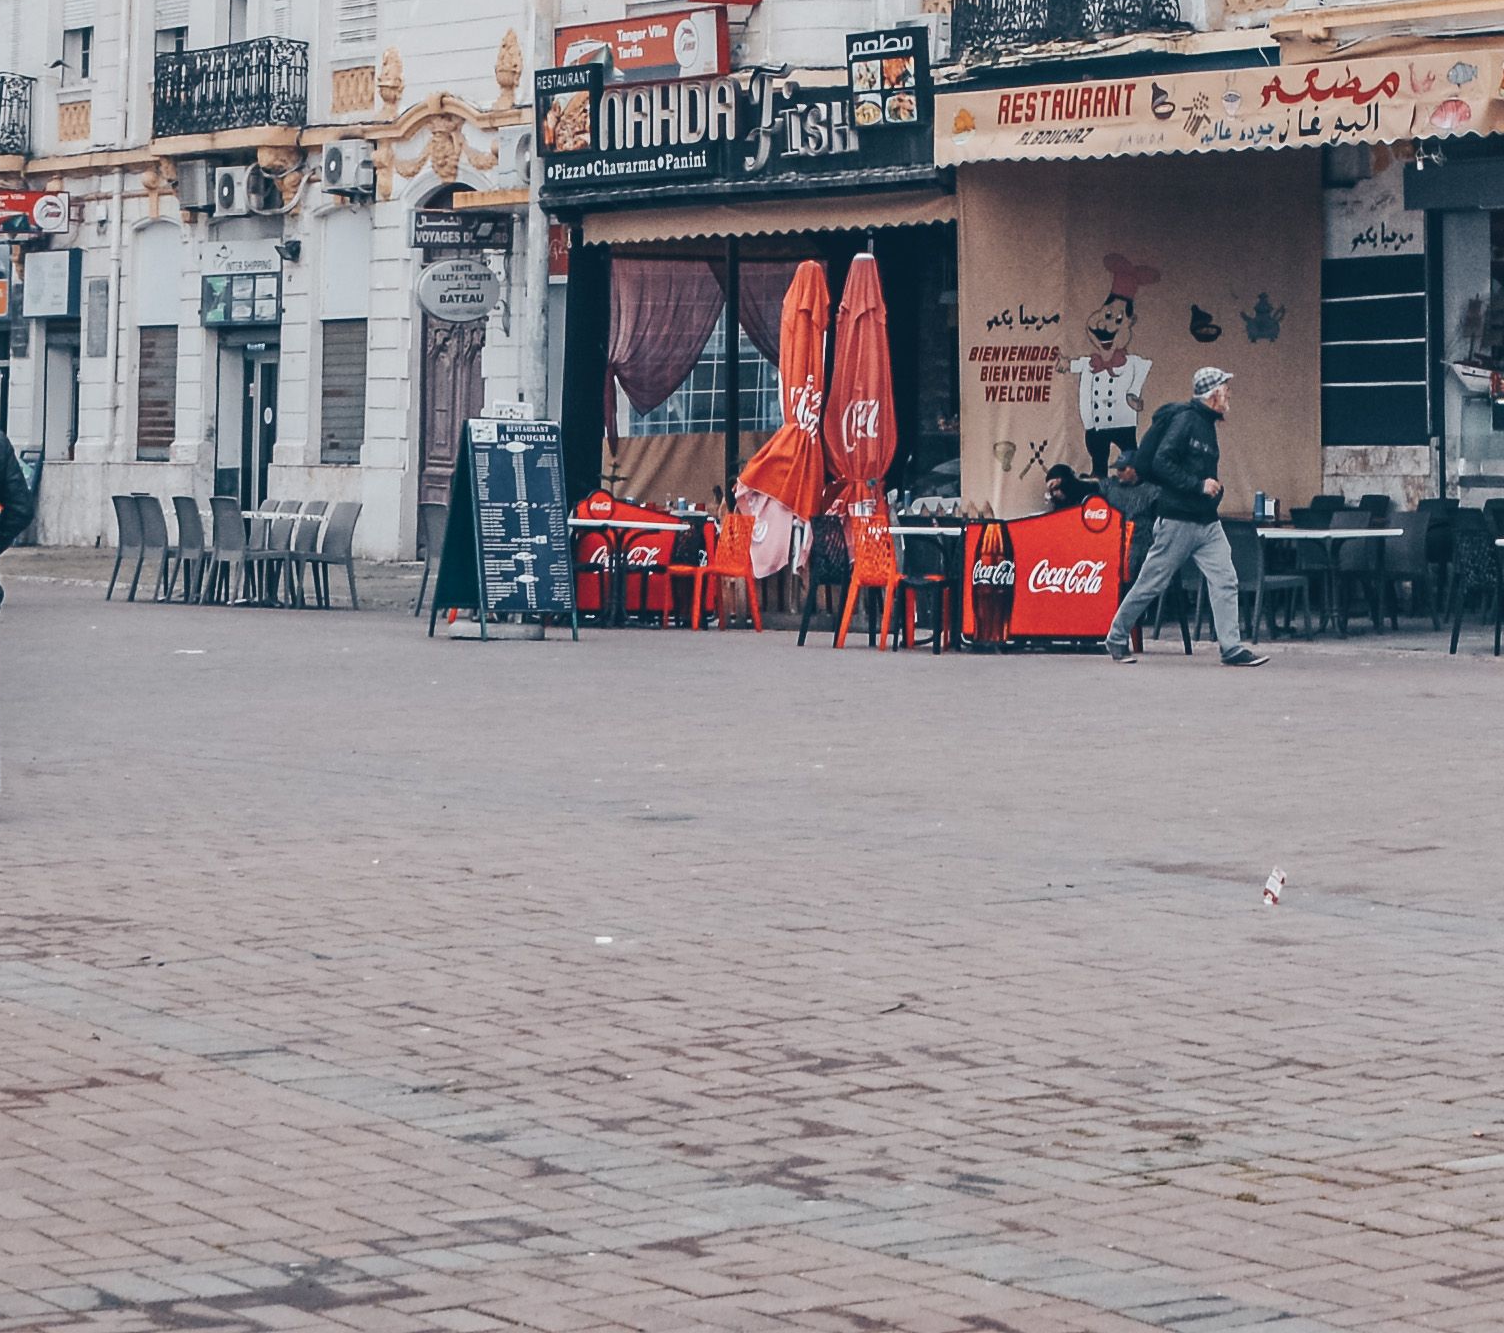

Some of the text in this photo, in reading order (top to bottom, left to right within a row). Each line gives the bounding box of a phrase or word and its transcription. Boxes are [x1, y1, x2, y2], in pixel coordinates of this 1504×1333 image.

[617, 24, 668, 43] Tanger Ville
[617, 45, 643, 60] Tarifa
[849, 35, 913, 60] مطعم
[536, 69, 591, 90] RESTAURANT
[598, 76, 736, 151] NAHDA
[998, 84, 1136, 125] RESTAURANT
[555, 150, 707, 180] Pizza Chawarma Panini
[415, 231, 461, 244] VOYAGES
[1381, 221, 1413, 251] مرحبا
[439, 294, 485, 303] BATEAU
[1019, 304, 1060, 331] مرحبا
[968, 346, 1060, 362] BIENVENIDOS
[980, 365, 1054, 382] BIENVENUE
[985, 385, 1051, 403] WELCOME
[1028, 559, 1108, 594] Coca-Cola
